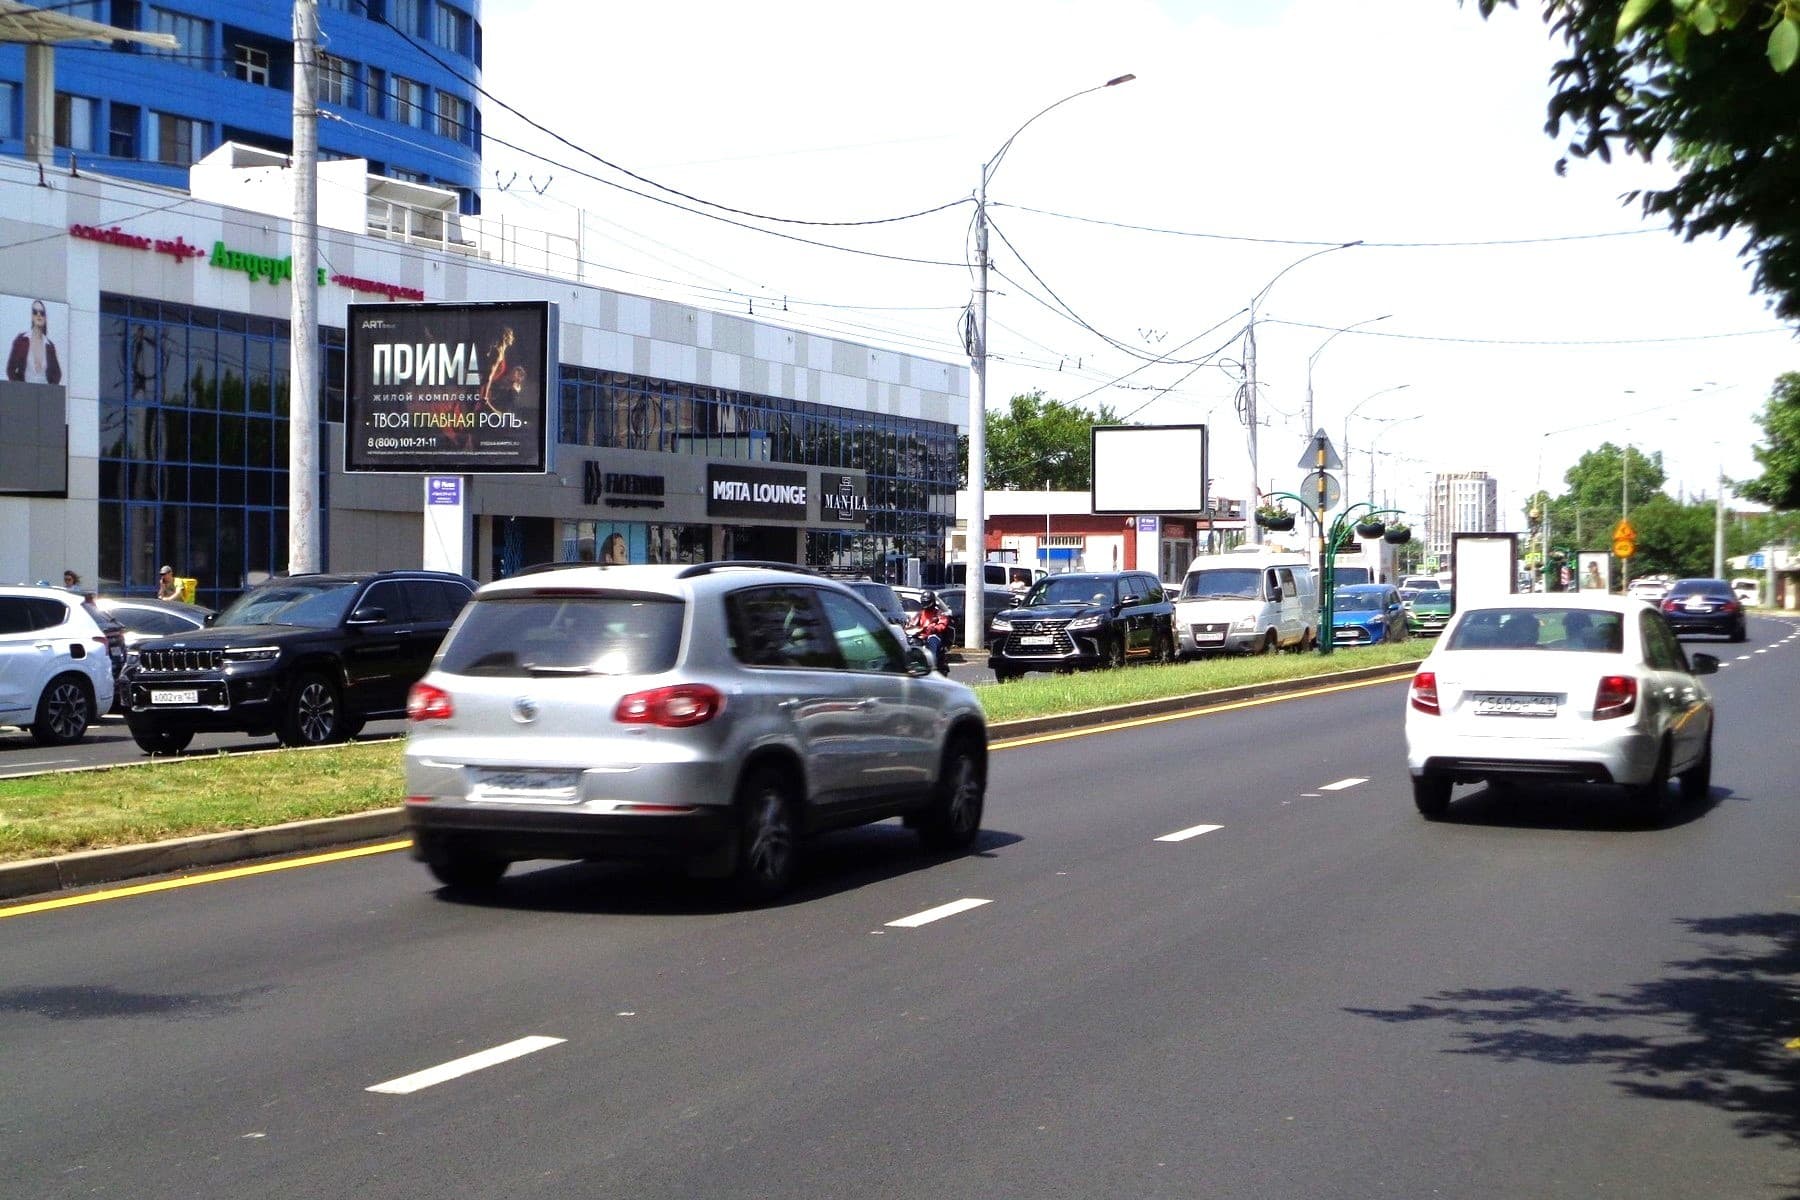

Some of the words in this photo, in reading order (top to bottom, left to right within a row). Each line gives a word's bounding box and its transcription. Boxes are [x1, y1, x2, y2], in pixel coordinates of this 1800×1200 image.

[373, 342, 481, 386] ПРИМА
[373, 392, 413, 402] жилой
[418, 393, 481, 402] комплекс
[372, 412, 410, 428] ТВОЯ
[413, 412, 475, 428] ГЛАВНАЯ
[479, 412, 522, 428] РОЛЬ
[367, 437, 374, 448] 8
[375, 437, 399, 449] (800)
[400, 437, 437, 448] 101-21-11
[713, 480, 751, 502] МЯТА
[753, 483, 807, 505] LOUNGE
[824, 493, 868, 511] MANILA
